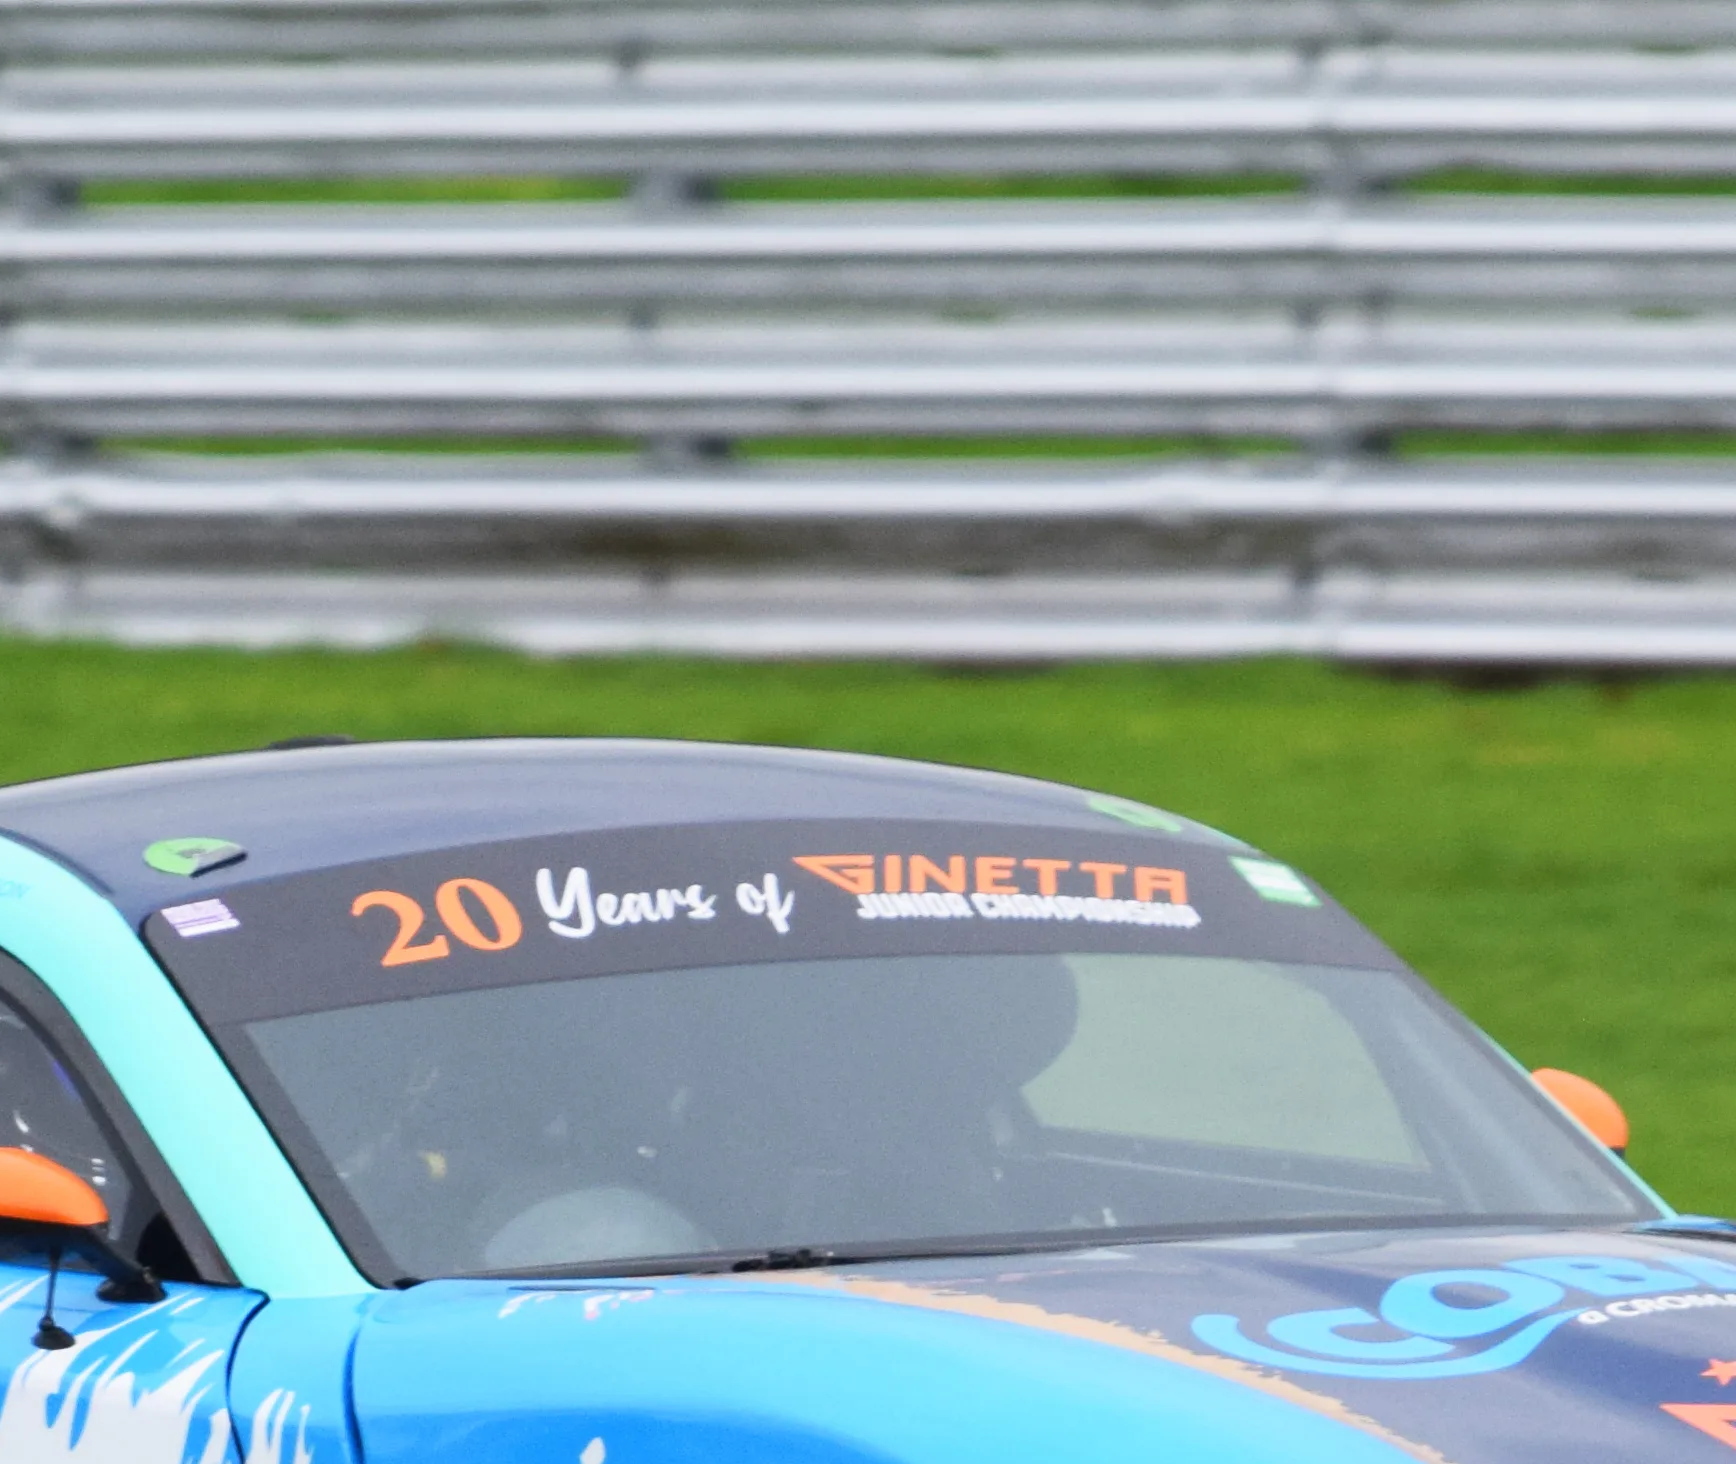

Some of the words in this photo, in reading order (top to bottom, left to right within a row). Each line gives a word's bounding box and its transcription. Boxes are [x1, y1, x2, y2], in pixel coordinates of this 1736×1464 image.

[792, 854, 1188, 905] GINETTA
[351, 877, 523, 967] 20
[535, 866, 716, 939] Years
[736, 872, 794, 934] of
[856, 892, 974, 919] JUNIOR
[969, 892, 1202, 928] CHAMPIONSHIP
[1577, 1309, 1607, 1325] a
